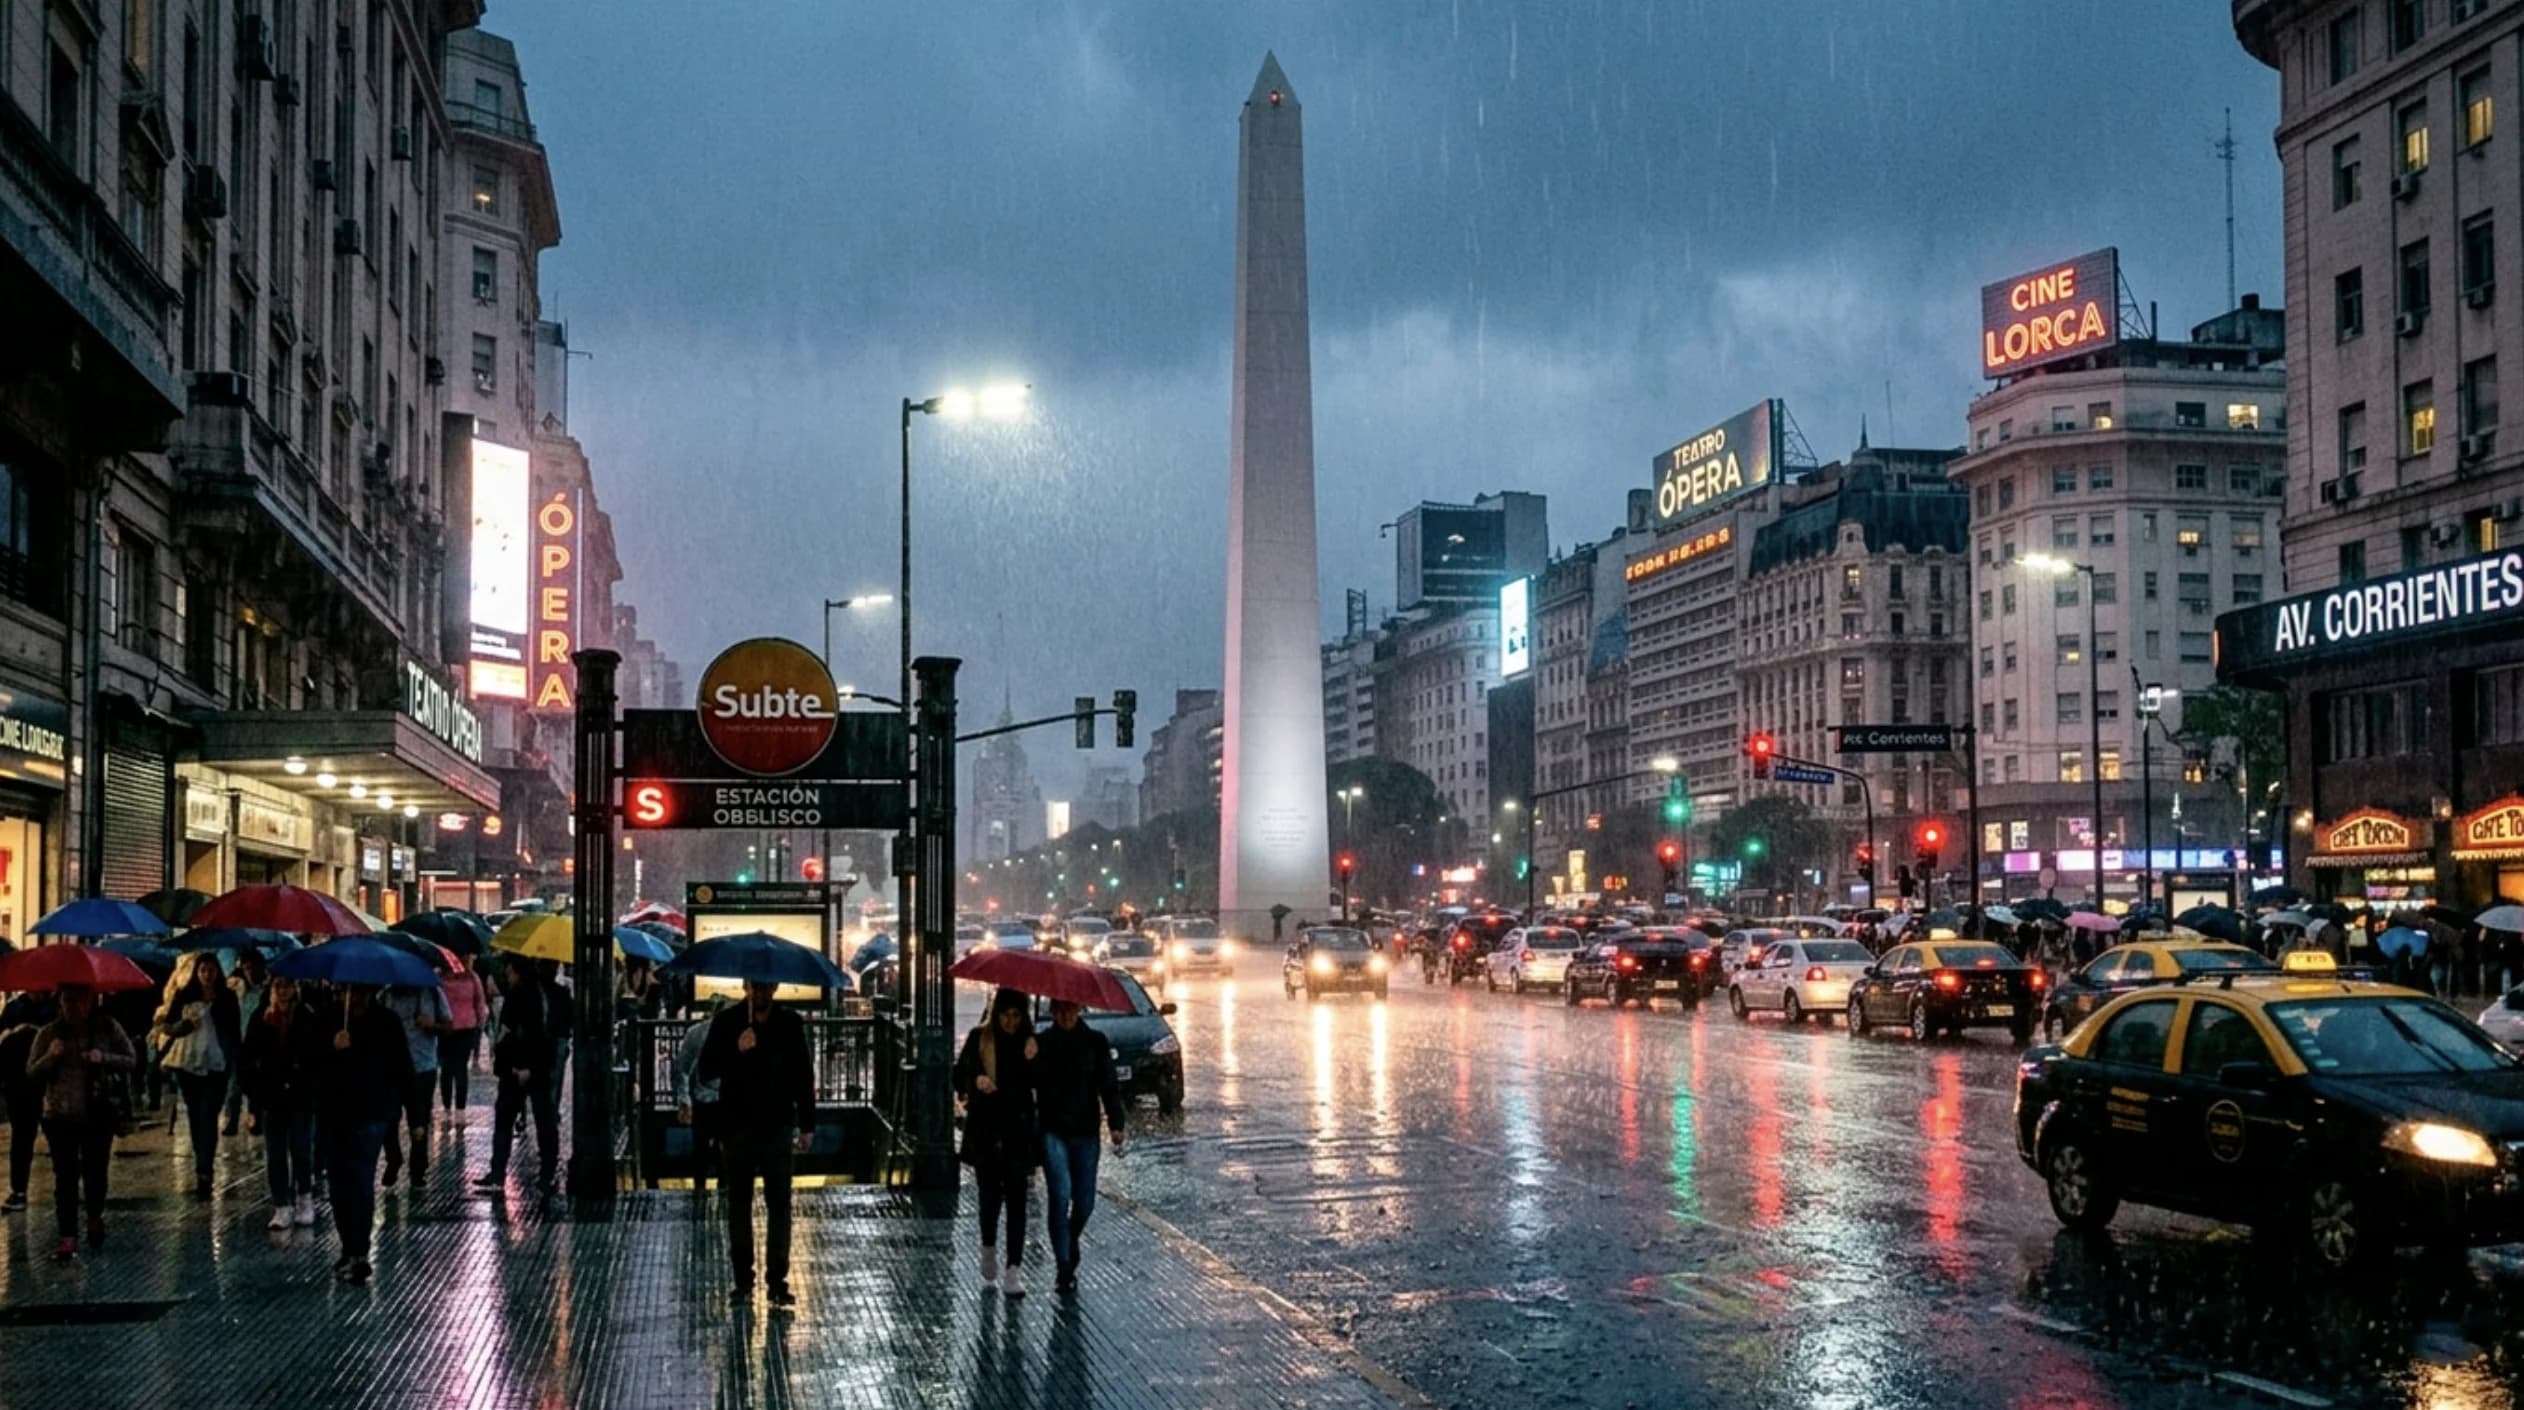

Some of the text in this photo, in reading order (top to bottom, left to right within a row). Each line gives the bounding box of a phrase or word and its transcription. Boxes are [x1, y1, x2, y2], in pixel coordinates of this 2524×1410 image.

[2010, 267, 2075, 312] CINE
[1985, 301, 2106, 367] LORCA
[1658, 451, 1743, 518] ÓPERA
[536, 492, 574, 707] ÓPERA
[2275, 553, 2523, 652] AV. CORRIENTES
[713, 684, 835, 719] Subte
[636, 787, 665, 821] S
[715, 785, 820, 805] ESTACIÓN
